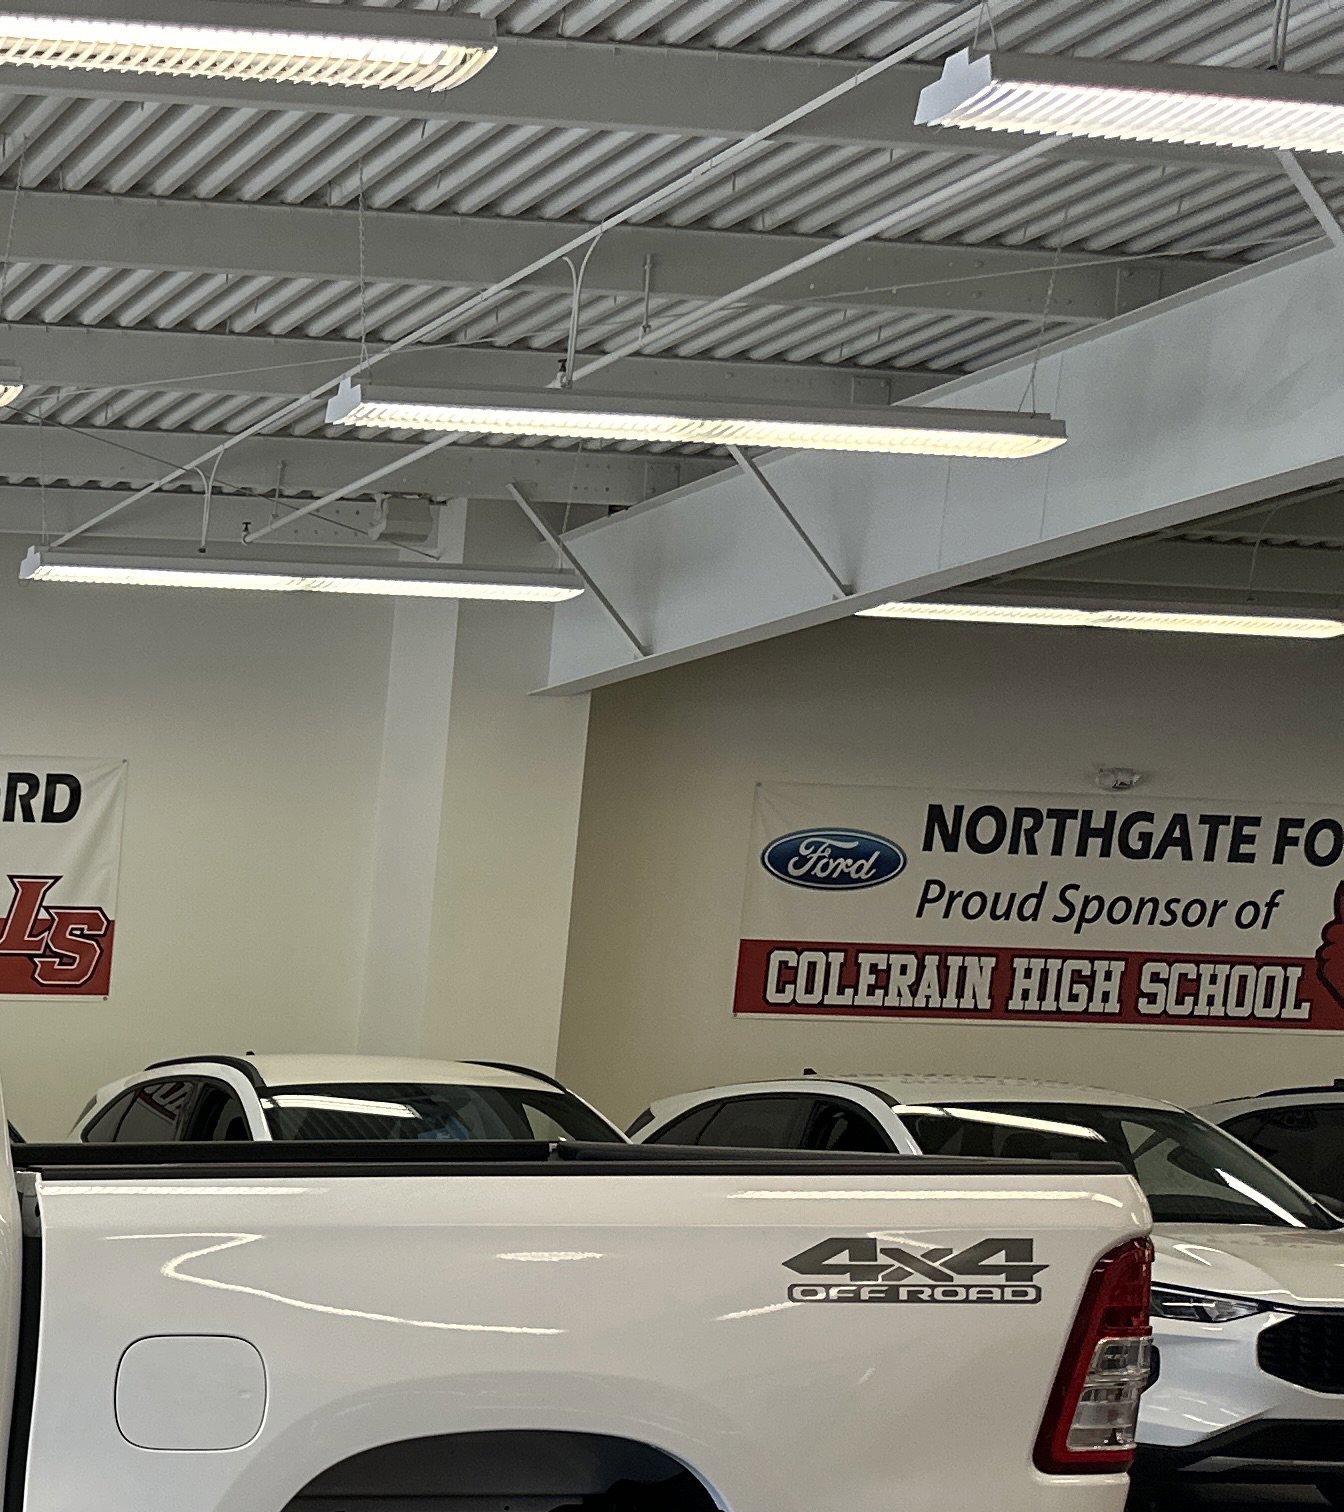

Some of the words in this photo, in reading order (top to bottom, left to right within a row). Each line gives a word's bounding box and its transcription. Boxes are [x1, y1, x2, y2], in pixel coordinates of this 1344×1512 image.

[787, 837, 881, 880] Ford
[922, 803, 1262, 863] NORTHGATE
[916, 879, 1048, 922] Proud
[1052, 883, 1228, 934] Sponsor
[1234, 889, 1285, 930] of
[765, 950, 997, 1010] COLERAIN
[1008, 956, 1125, 1014] HIGH
[1137, 961, 1311, 1019] SCHOOL
[792, 1285, 890, 1301] OFF
[898, 1286, 1038, 1301] ROAD
